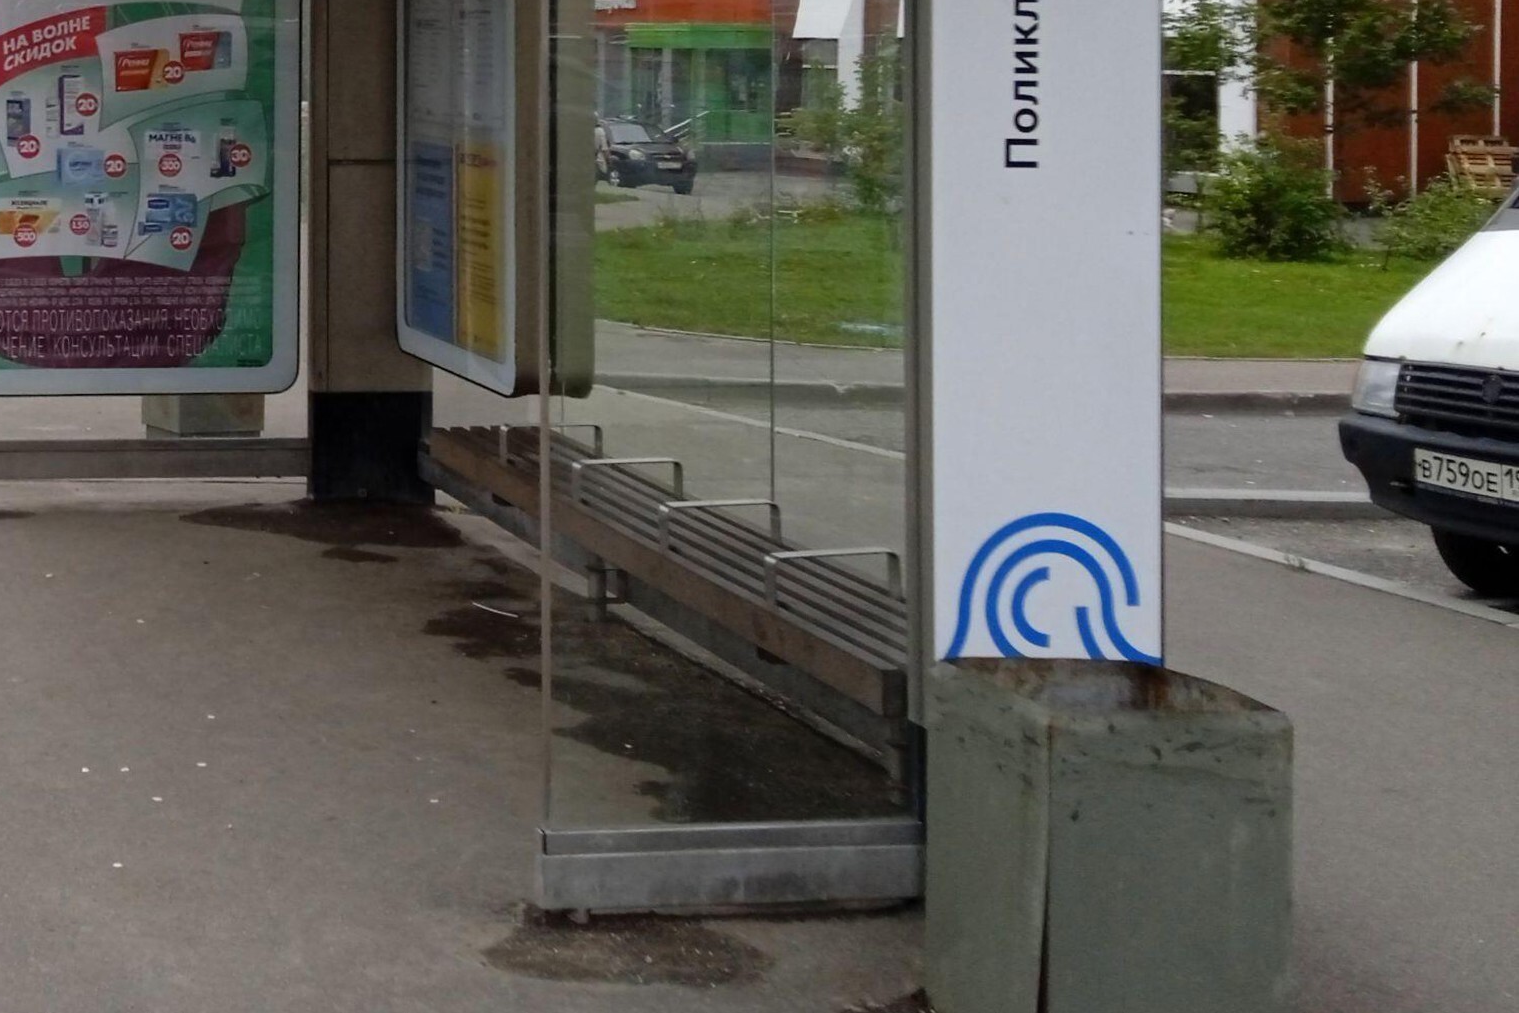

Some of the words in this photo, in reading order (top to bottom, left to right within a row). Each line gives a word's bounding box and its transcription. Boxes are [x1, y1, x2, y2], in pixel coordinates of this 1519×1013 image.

[3, 34, 29, 55] НА
[32, 16, 91, 43] ВОЛНЕ
[3, 35, 77, 71] СКИДОК
[148, 133, 183, 143] МАГНЕ
[53, 335, 159, 360] КОНСУЛЬТАЦИИ
